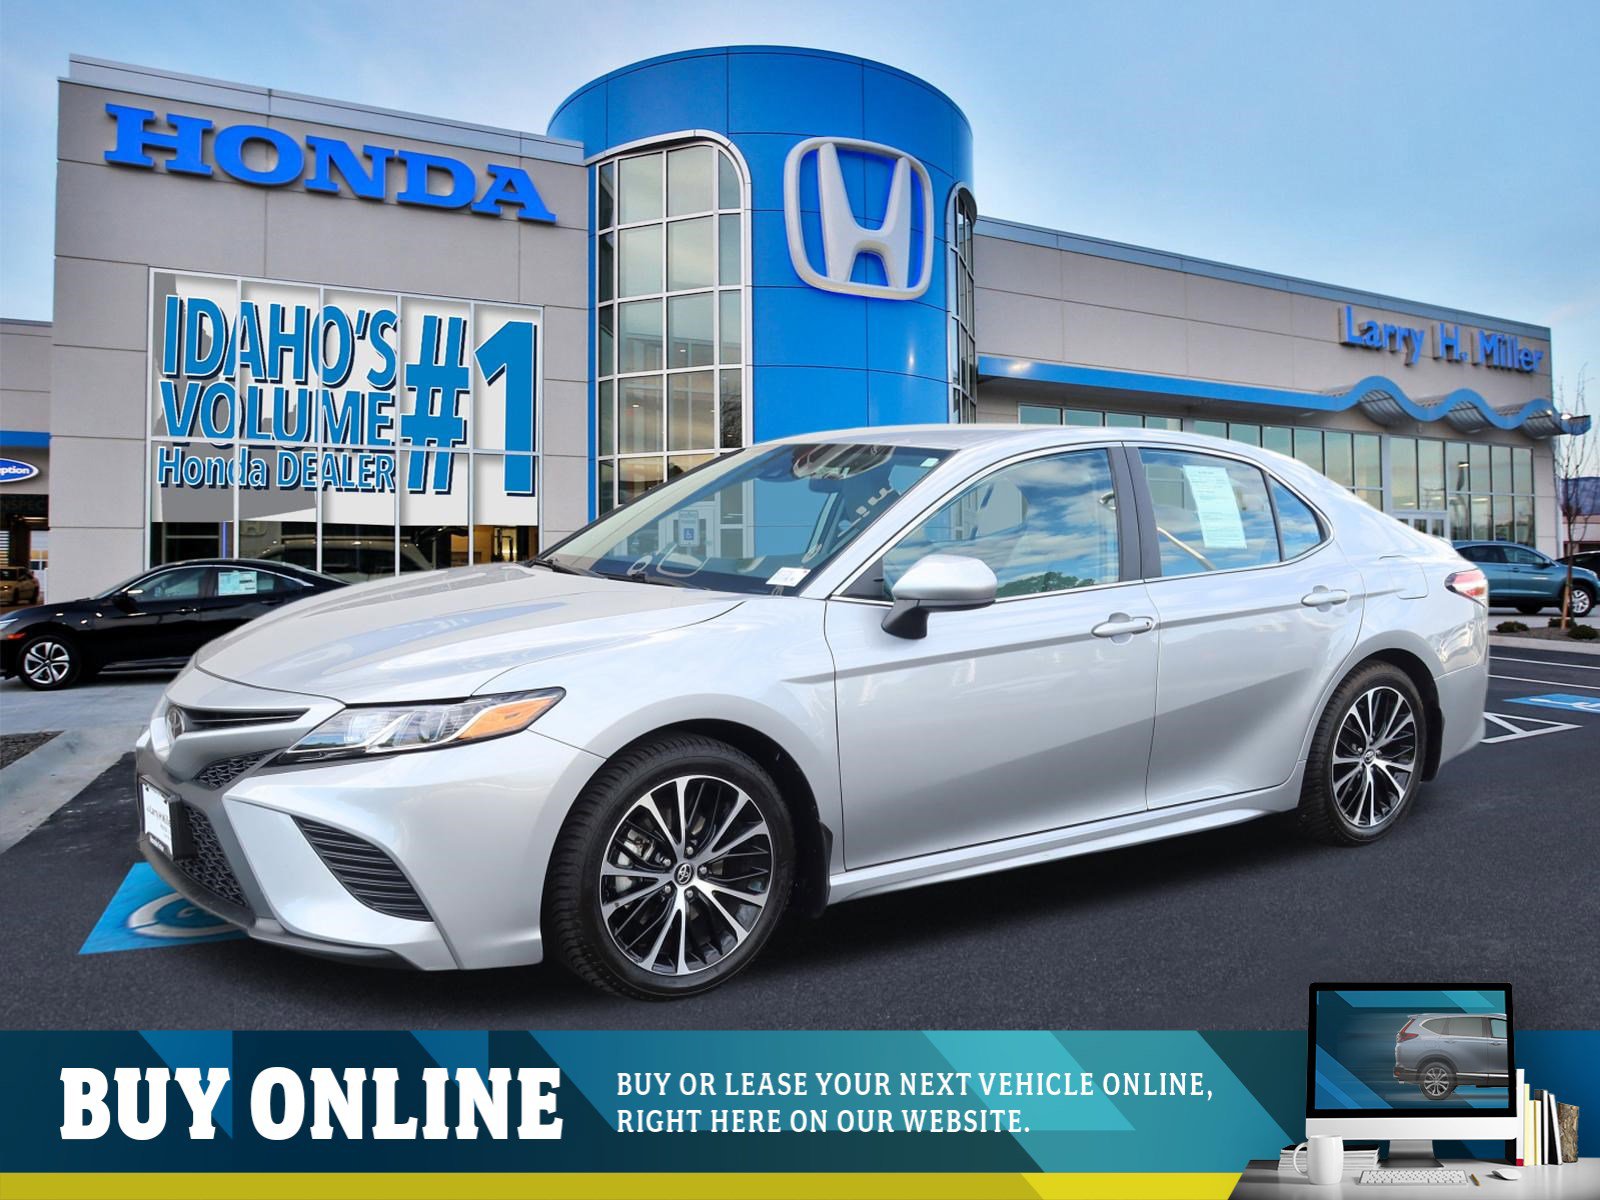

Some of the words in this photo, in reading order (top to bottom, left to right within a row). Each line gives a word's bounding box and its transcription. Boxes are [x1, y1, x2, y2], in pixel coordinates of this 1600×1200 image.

[104, 103, 558, 224] HONDA
[162, 294, 400, 388] IDAHO'S
[1340, 304, 1424, 366] Larry
[1433, 322, 1468, 363] H.
[1472, 329, 1543, 373] Miller
[159, 380, 397, 453] VOLUME
[400, 315, 538, 497] #1
[156, 446, 270, 490] Honda
[276, 450, 396, 493] DEALER
